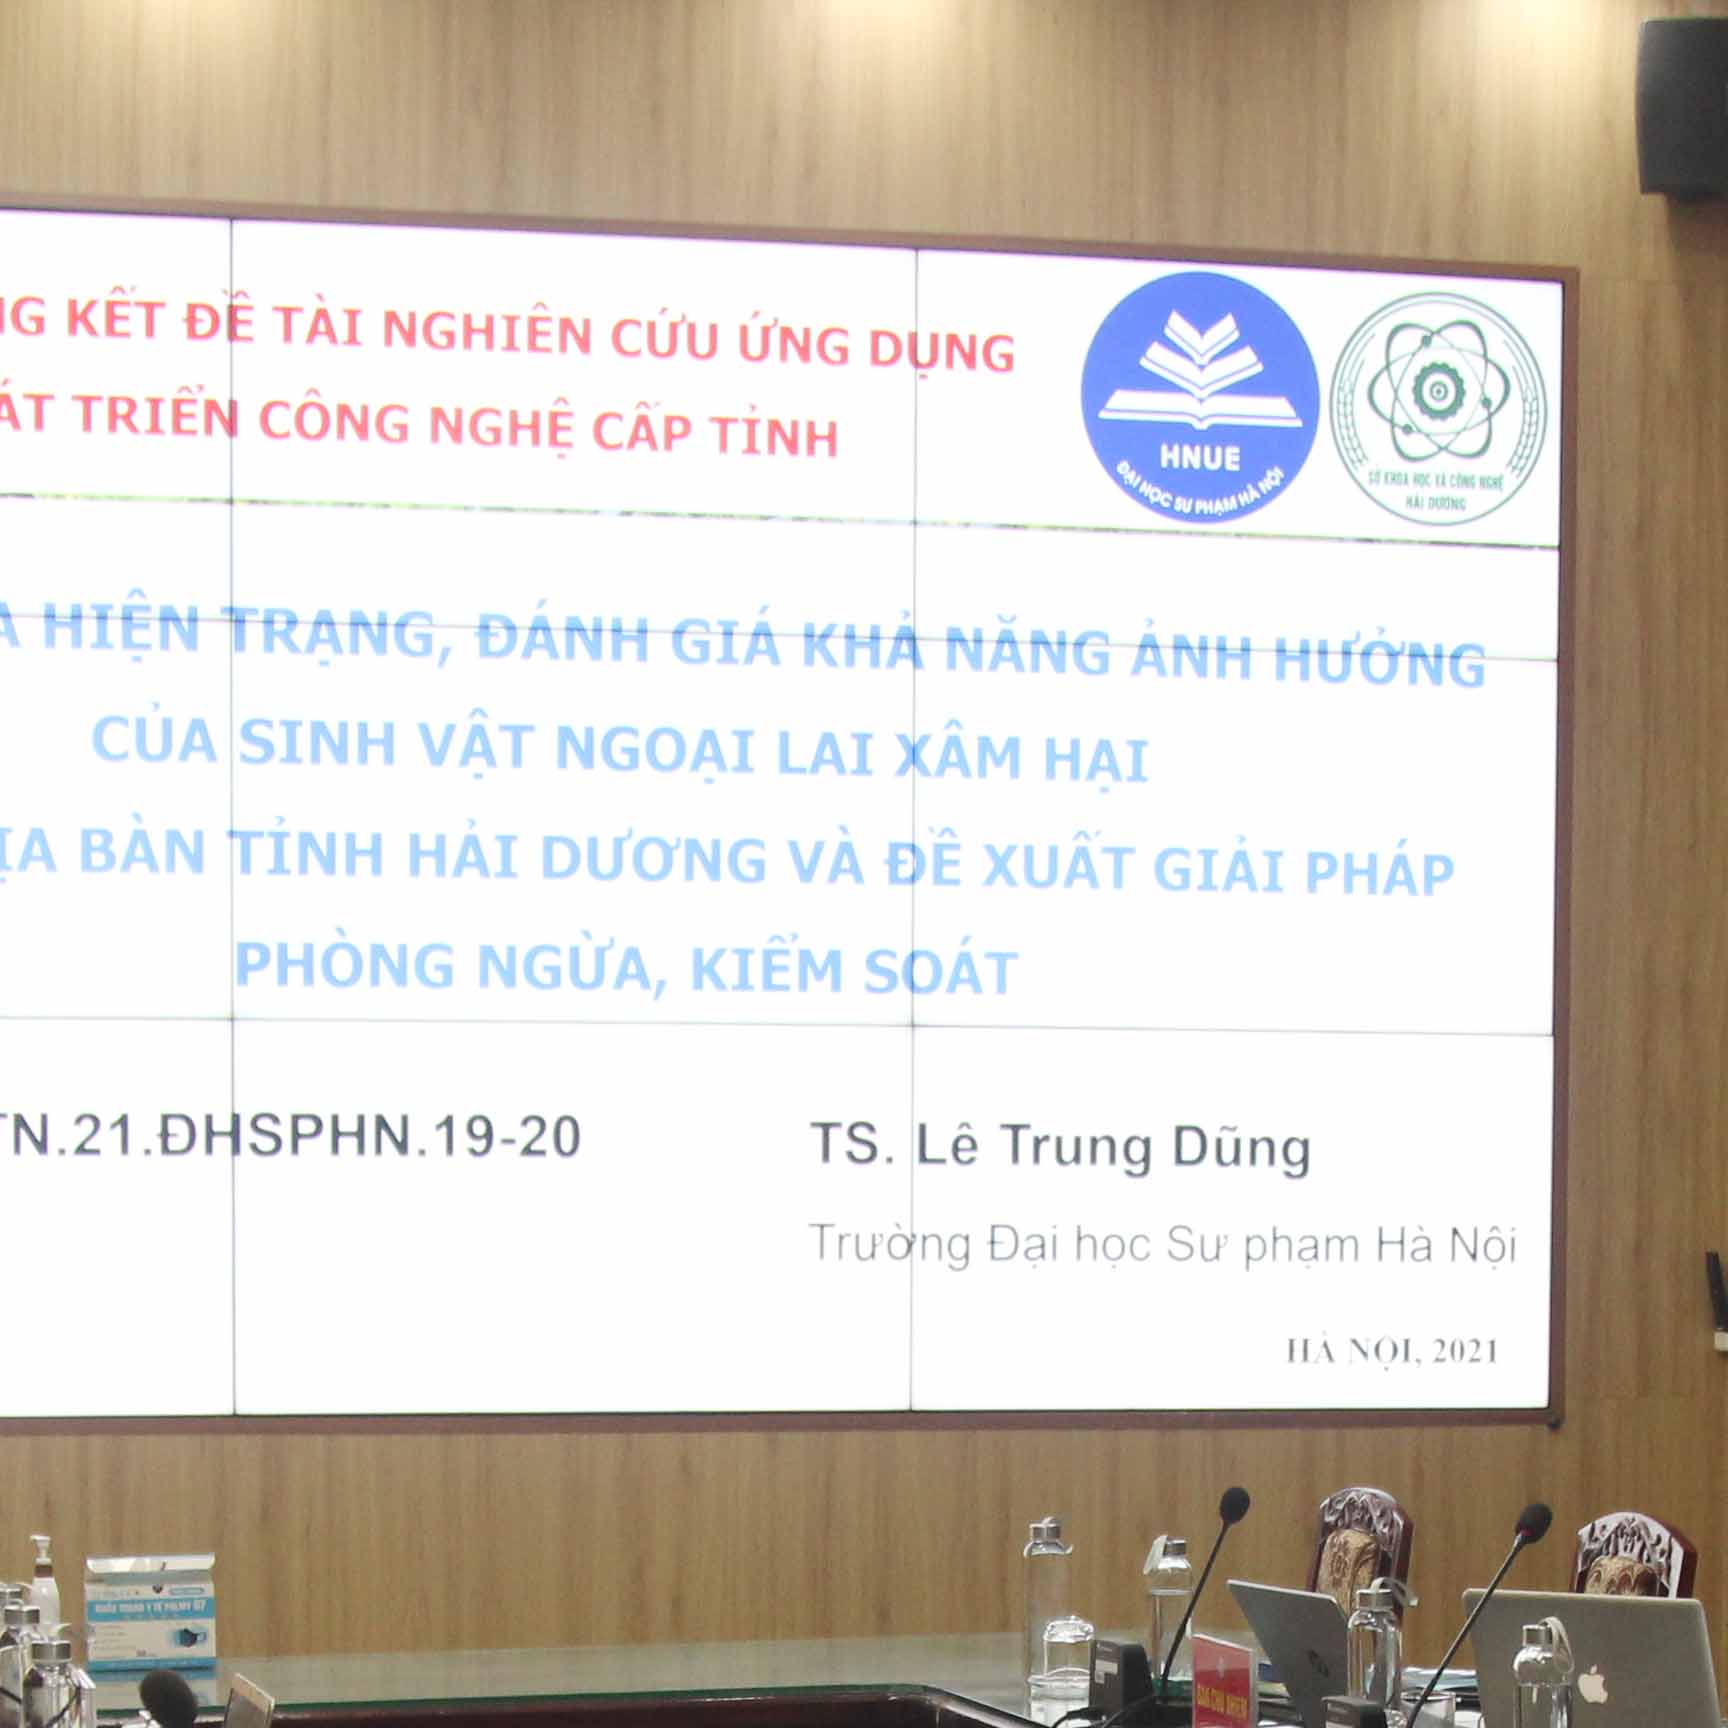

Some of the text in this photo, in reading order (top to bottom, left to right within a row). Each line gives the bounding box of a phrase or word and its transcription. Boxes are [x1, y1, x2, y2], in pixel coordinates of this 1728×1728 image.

[67, 287, 167, 340] KẾT
[184, 290, 255, 344] ĐỀ
[272, 293, 363, 347] TÀI
[384, 303, 591, 356] NGHIÊN
[612, 309, 718, 362] CỨU
[739, 311, 849, 367] ỨNG
[870, 329, 1014, 380] DỤNG
[71, 384, 239, 439] TRIỂN
[259, 388, 408, 445] CÔNG
[432, 397, 574, 459] NGHỆ
[592, 401, 692, 452] CẤP
[710, 404, 837, 459] TỈNH
[1159, 442, 1242, 472] HNUE
[43, 587, 200, 662] HIỆN
[229, 604, 450, 668] TRẠNG,
[475, 601, 649, 662] ĐÁNH
[672, 604, 781, 666] GIÁ
[803, 609, 925, 670] KHẢ
[945, 614, 1110, 675] NĂNG
[1131, 618, 1253, 680] ẢNH
[1275, 626, 1486, 688] HƯỞNG
[92, 704, 1149, 793] CỦA SINH VẬT NGOẠI LAI XÂM HẠI
[80, 811, 204, 874] BÀN
[225, 816, 382, 877] TỈNH
[409, 818, 518, 878] HẢI
[543, 828, 766, 883] DƯƠNG
[788, 824, 864, 885] VÀ
[884, 826, 960, 886] ĐỀ
[982, 831, 1136, 890] XUẤT
[1154, 835, 1284, 893] GIẢI
[1307, 838, 1455, 896] PHÁP
[236, 928, 1020, 1000] PHÒNG NGỪA, KIỂM SOÁT
[810, 1121, 1310, 1180] TS. Lê Trung Dũng
[808, 1222, 1516, 1272] Trường Đại học Sư phạm Hà Nội
[1432, 1338, 1496, 1364] 2021
